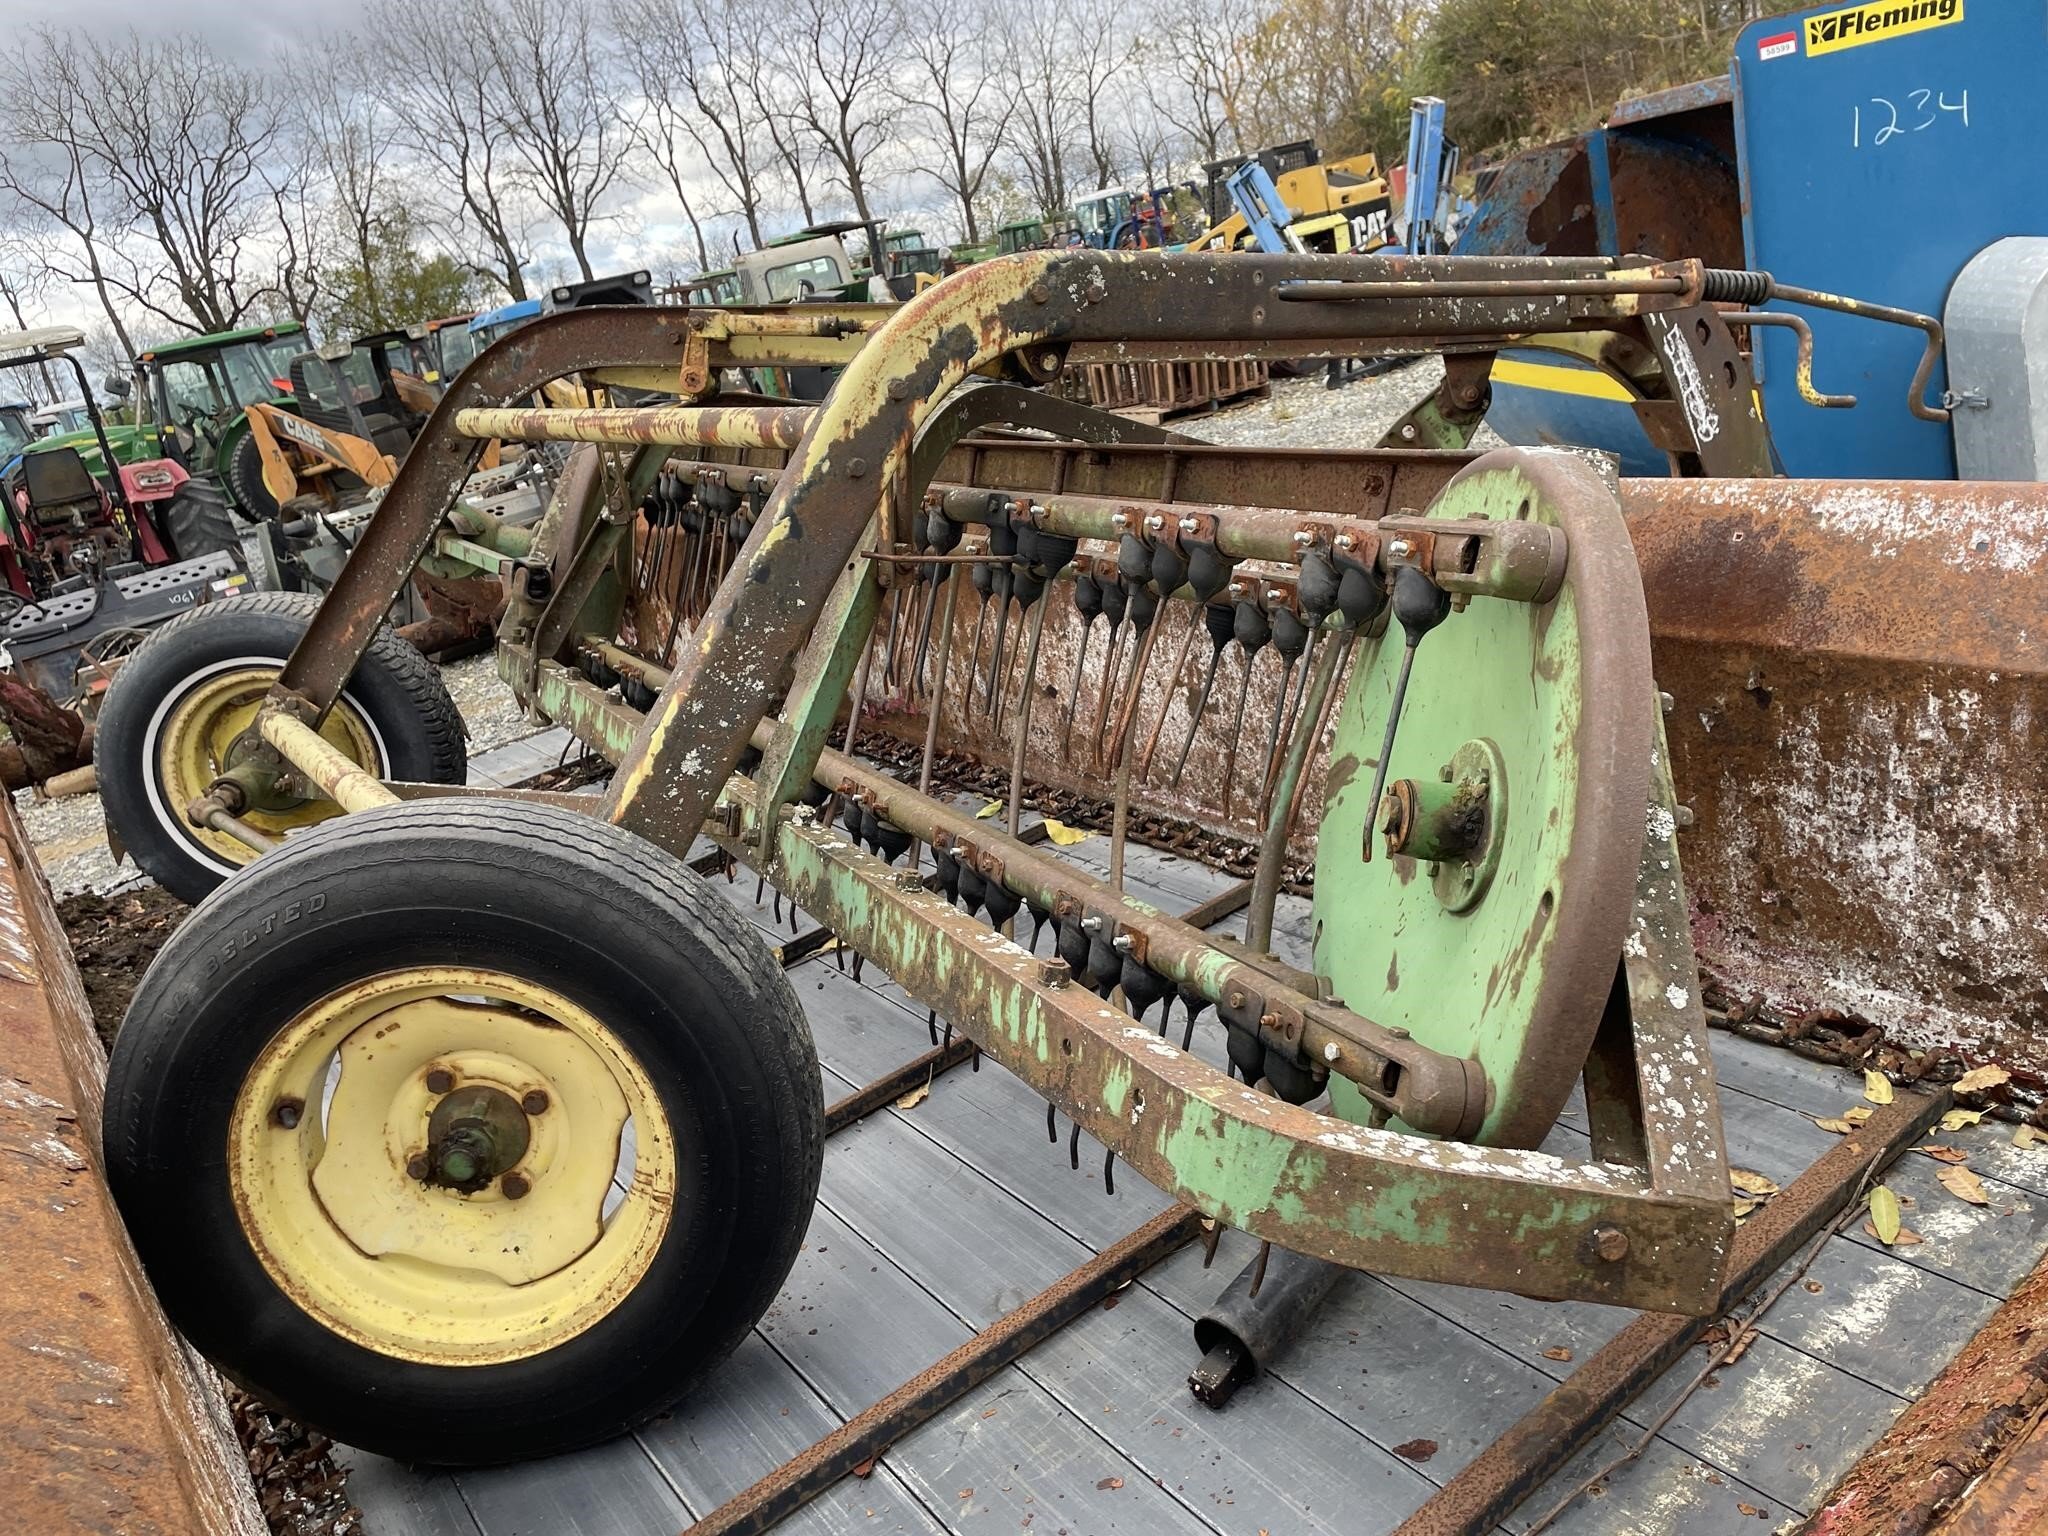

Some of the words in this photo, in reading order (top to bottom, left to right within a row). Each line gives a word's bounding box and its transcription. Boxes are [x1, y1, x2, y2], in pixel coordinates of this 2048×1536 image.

[1838, 0, 1956, 38] Fleming
[1853, 88, 1969, 148] 1234
[1350, 209, 1388, 252] CAT
[283, 415, 326, 451] CASE
[168, 589, 195, 604] 1061
[205, 892, 327, 979] BELTED
